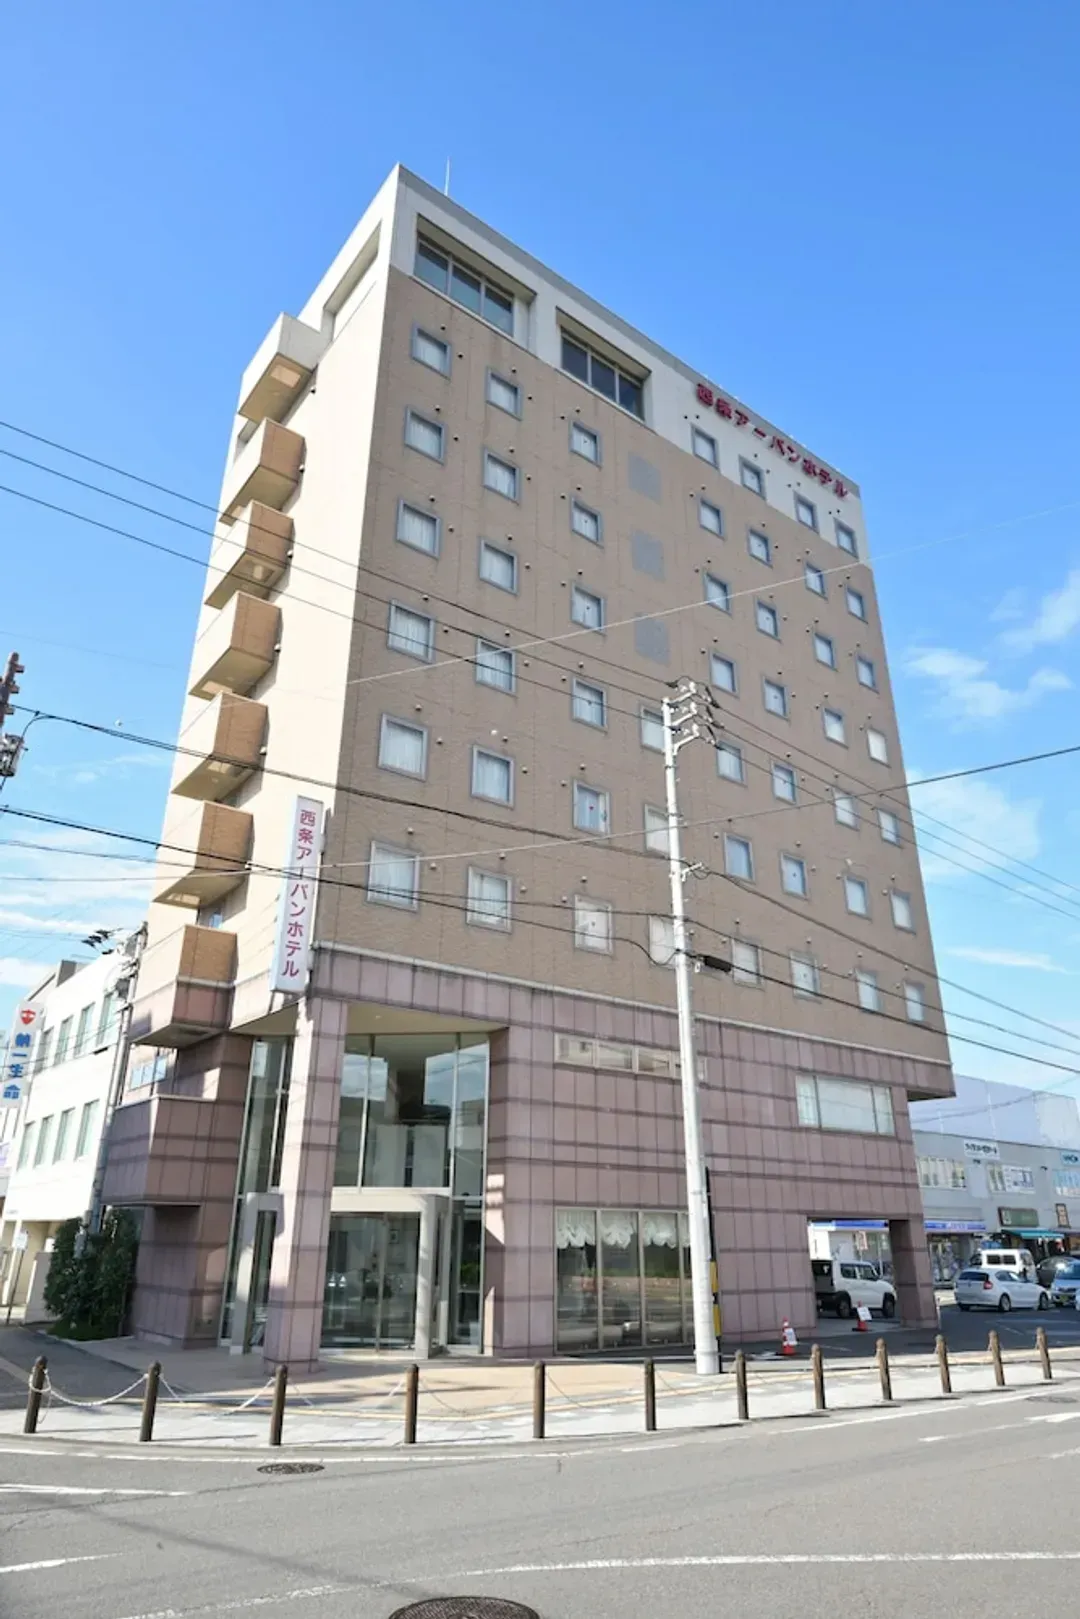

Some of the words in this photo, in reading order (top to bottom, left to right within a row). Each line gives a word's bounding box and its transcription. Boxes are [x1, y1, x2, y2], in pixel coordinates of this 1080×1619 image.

[696, 383, 848, 499] 西条アーバンホテル
[281, 809, 317, 978] 西条アーバンホテル
